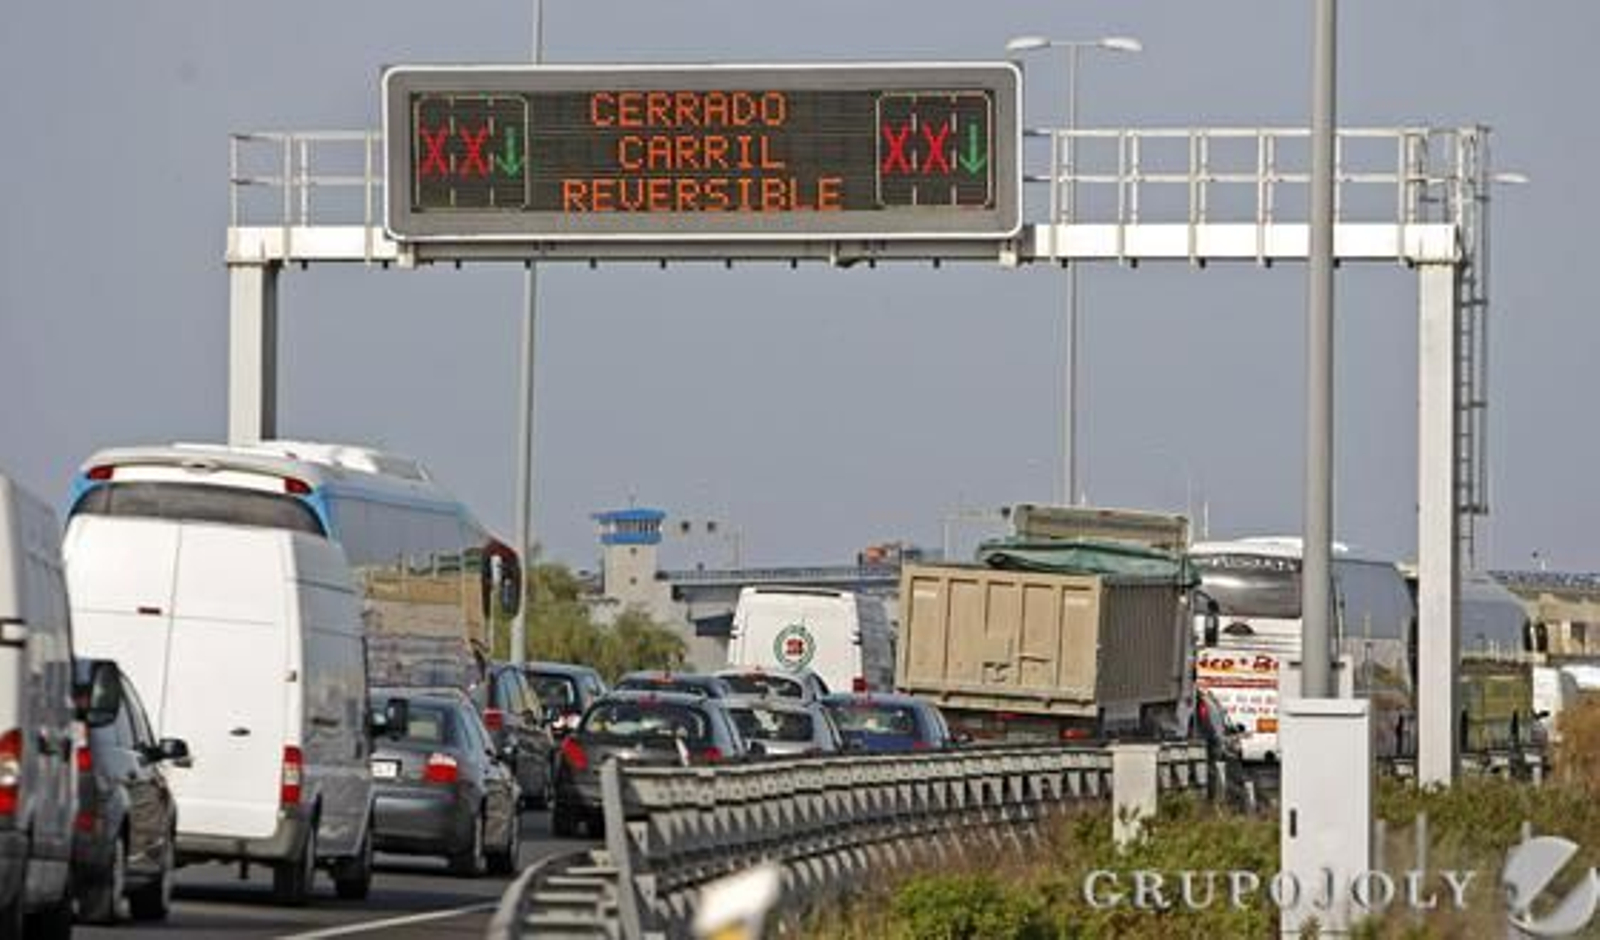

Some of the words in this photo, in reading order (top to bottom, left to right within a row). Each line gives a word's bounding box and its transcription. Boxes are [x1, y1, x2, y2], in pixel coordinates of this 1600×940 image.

[593, 92, 786, 127] CERRADO
[619, 135, 786, 169] CARRIL
[563, 178, 843, 212] REVERSIBLE
